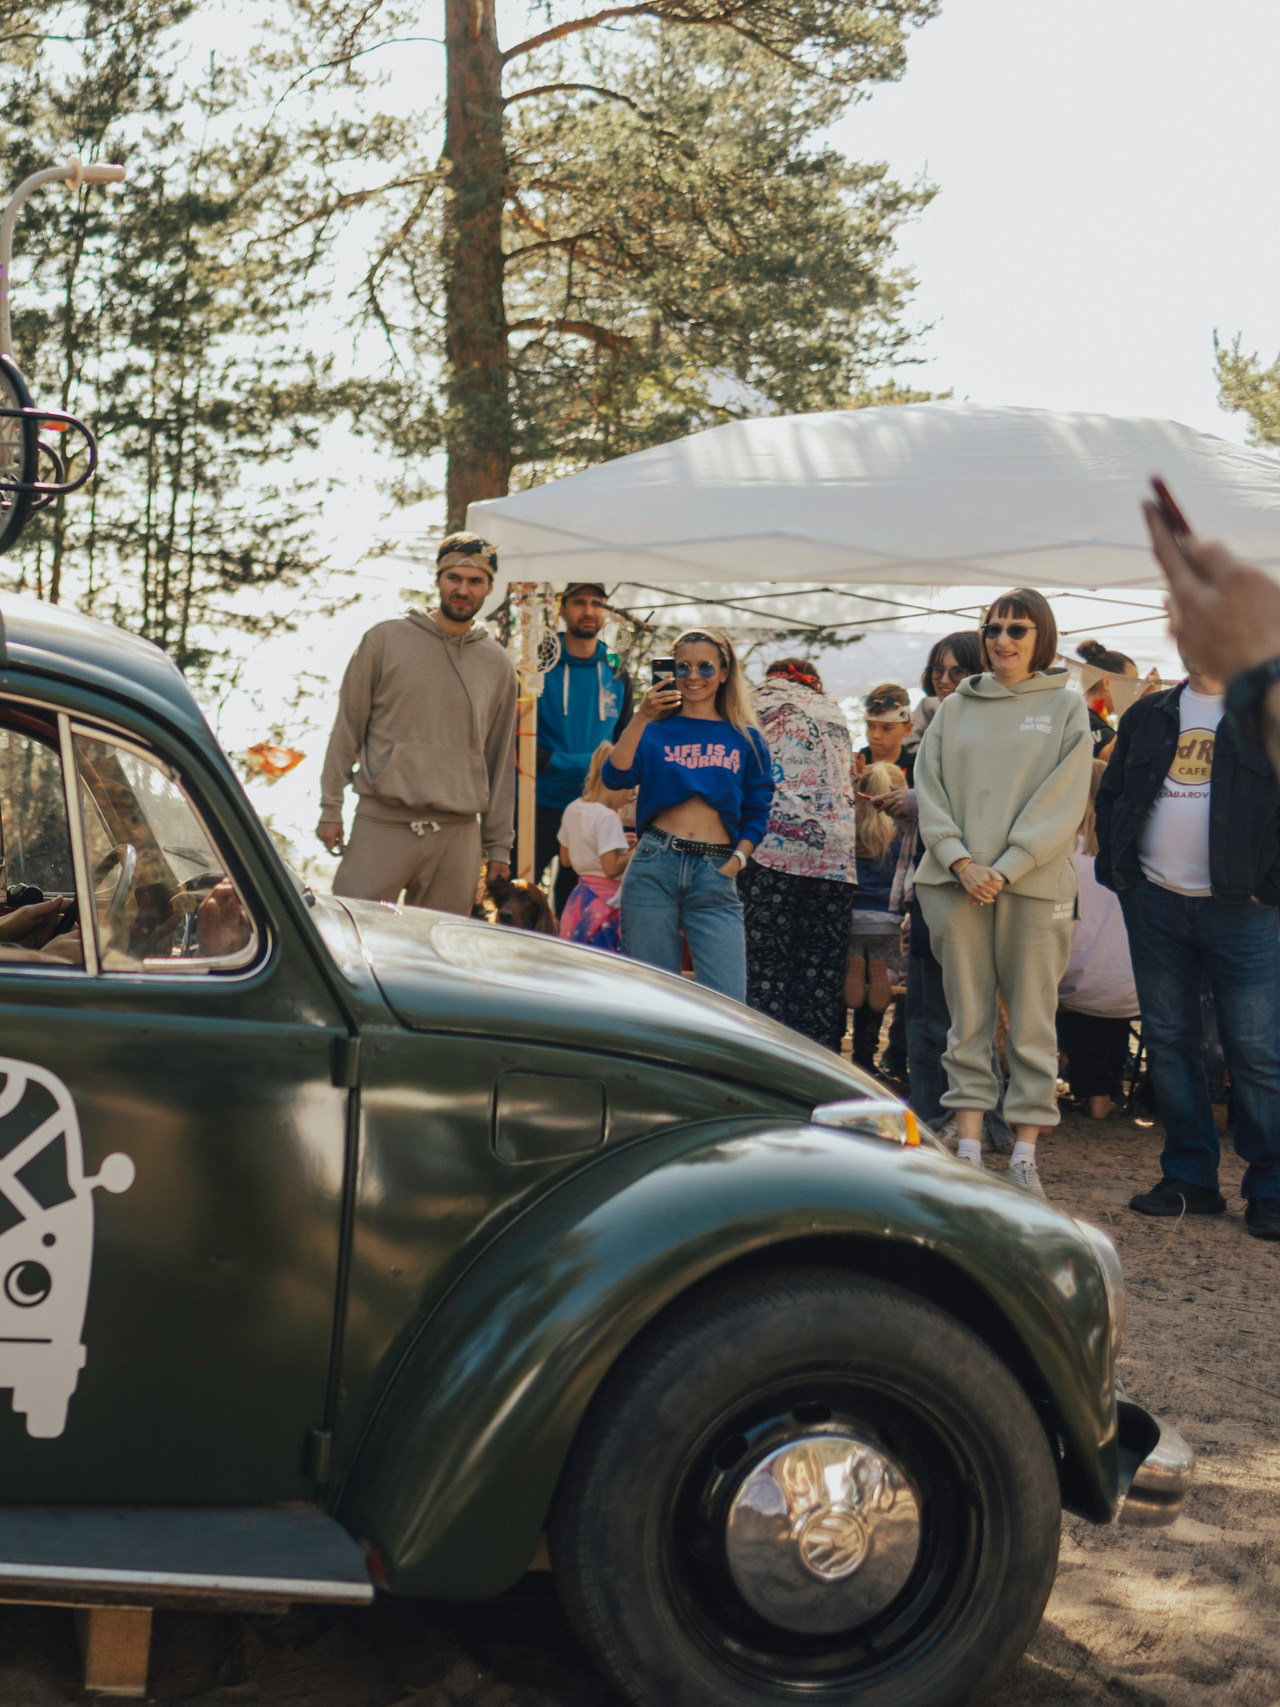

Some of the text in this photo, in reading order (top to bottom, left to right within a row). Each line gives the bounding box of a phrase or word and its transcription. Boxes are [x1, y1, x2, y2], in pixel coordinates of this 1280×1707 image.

[664, 743, 740, 762] LIFE IS A
[664, 753, 740, 774] JOURNEY
[1178, 767, 1208, 776] CAFE
